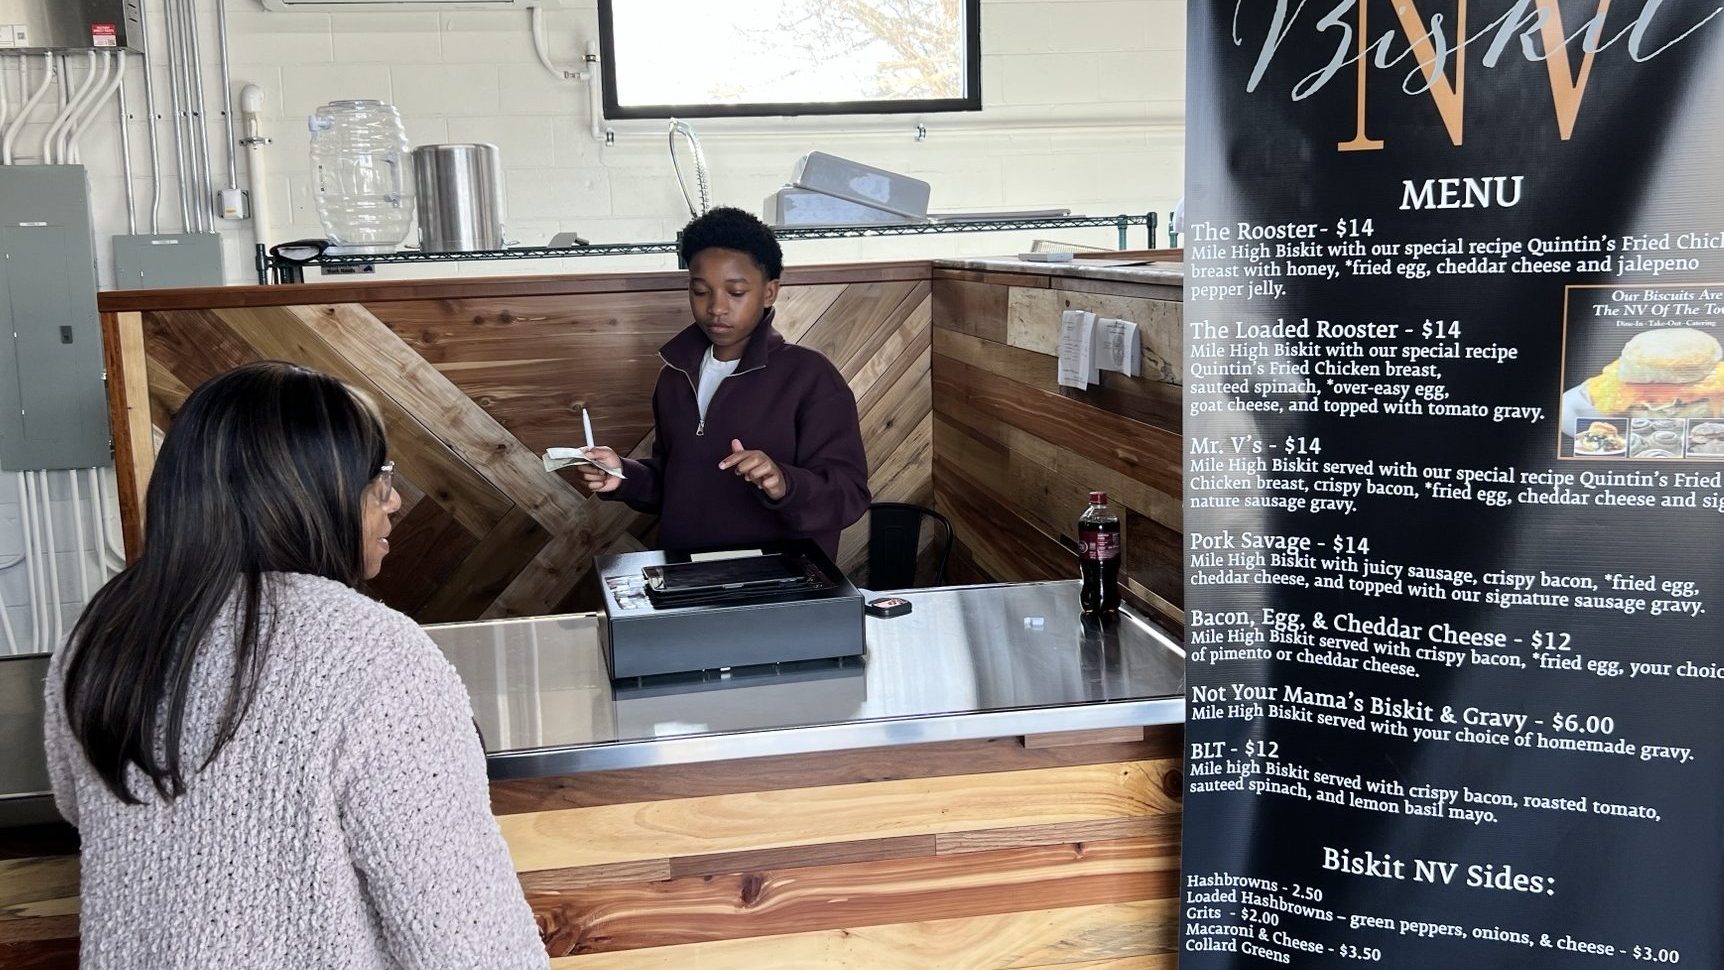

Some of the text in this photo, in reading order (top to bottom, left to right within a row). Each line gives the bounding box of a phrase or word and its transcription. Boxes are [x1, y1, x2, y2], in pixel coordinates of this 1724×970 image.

[1338, 0, 1607, 152] NV
[1399, 176, 1524, 210] MENU
[1336, 218, 1374, 238] $14
[1275, 233, 1670, 260] Biskit with our special recipe Quintin's Fried
[1286, 260, 1339, 280] honey,
[1397, 263, 1431, 279] egg,
[1436, 257, 1507, 274] cheddar
[1511, 256, 1571, 273] cheese
[1576, 255, 1612, 272] and
[1616, 254, 1699, 277] jalepeno
[1247, 279, 1286, 300] jelly.
[1612, 289, 1723, 302] Our Biscuits Are
[1592, 303, 1700, 317] The NV Of The
[1235, 318, 1461, 339] Loaded Rooster $14
[1325, 341, 1518, 363] with our special recipe
[1190, 359, 1441, 379] Quintin's Fried Chicken breast,
[1190, 378, 1249, 394] sauteed
[1254, 378, 1321, 398] spinach,
[1415, 385, 1449, 401] egg,
[1288, 396, 1545, 423] and topped with tomato gravy.
[1191, 434, 1321, 454] Mr. V's $14
[1323, 460, 1722, 490] served our special recipe Quintin's Fried
[1244, 496, 1357, 515] sausage gravy.
[1255, 478, 1309, 493] breast,
[1314, 479, 1362, 497] crispy
[1366, 478, 1419, 499] bacon,
[1477, 490, 1512, 507] egg,
[1518, 487, 1590, 505] cheddar
[1595, 489, 1656, 507] cheese
[1661, 491, 1696, 507] and
[1190, 530, 1370, 555] Pork Savage $14
[1362, 558, 1403, 580] juicy
[1408, 567, 1478, 586] sausage,
[1483, 570, 1536, 590] crispy
[1540, 571, 1598, 591] bacon,
[1661, 581, 1699, 597] egg,
[1253, 569, 1705, 617] cheese, topped with our signature sausage gravy.
[1191, 608, 1571, 651] Bacon, Egg, & Cheddar Cheese $12
[1191, 646, 1420, 677] of pimento or cheddar cheese.
[1319, 637, 1369, 652] served
[1416, 646, 1466, 667] crispy
[1470, 648, 1526, 669] bacon,
[1587, 660, 1624, 677] egg,
[1630, 662, 1672, 678] your
[1192, 684, 1614, 734] Not Your Mama's Biskit & Gravy $6.00
[1268, 705, 1694, 764] Biskit served your choice of homemade gravy.
[1190, 739, 1279, 759] BLT $12
[1189, 777, 1498, 825] sauteed spinach, lemon basil mayo.
[1226, 759, 1661, 822] high Biskit served crispy bacon, roasted tomato,
[1322, 847, 1555, 896] Biskit NV Sides:
[1187, 872, 1322, 902] Hashbrowns 2.50
[1186, 905, 1279, 926] Grits $2.00
[1186, 888, 1679, 963] Loaded Hashbrowns green peppers, onions, & cheese $3.00
[1185, 923, 1381, 961] Macaroni & Cheese $3.50
[1186, 937, 1290, 964] Collard Greens
